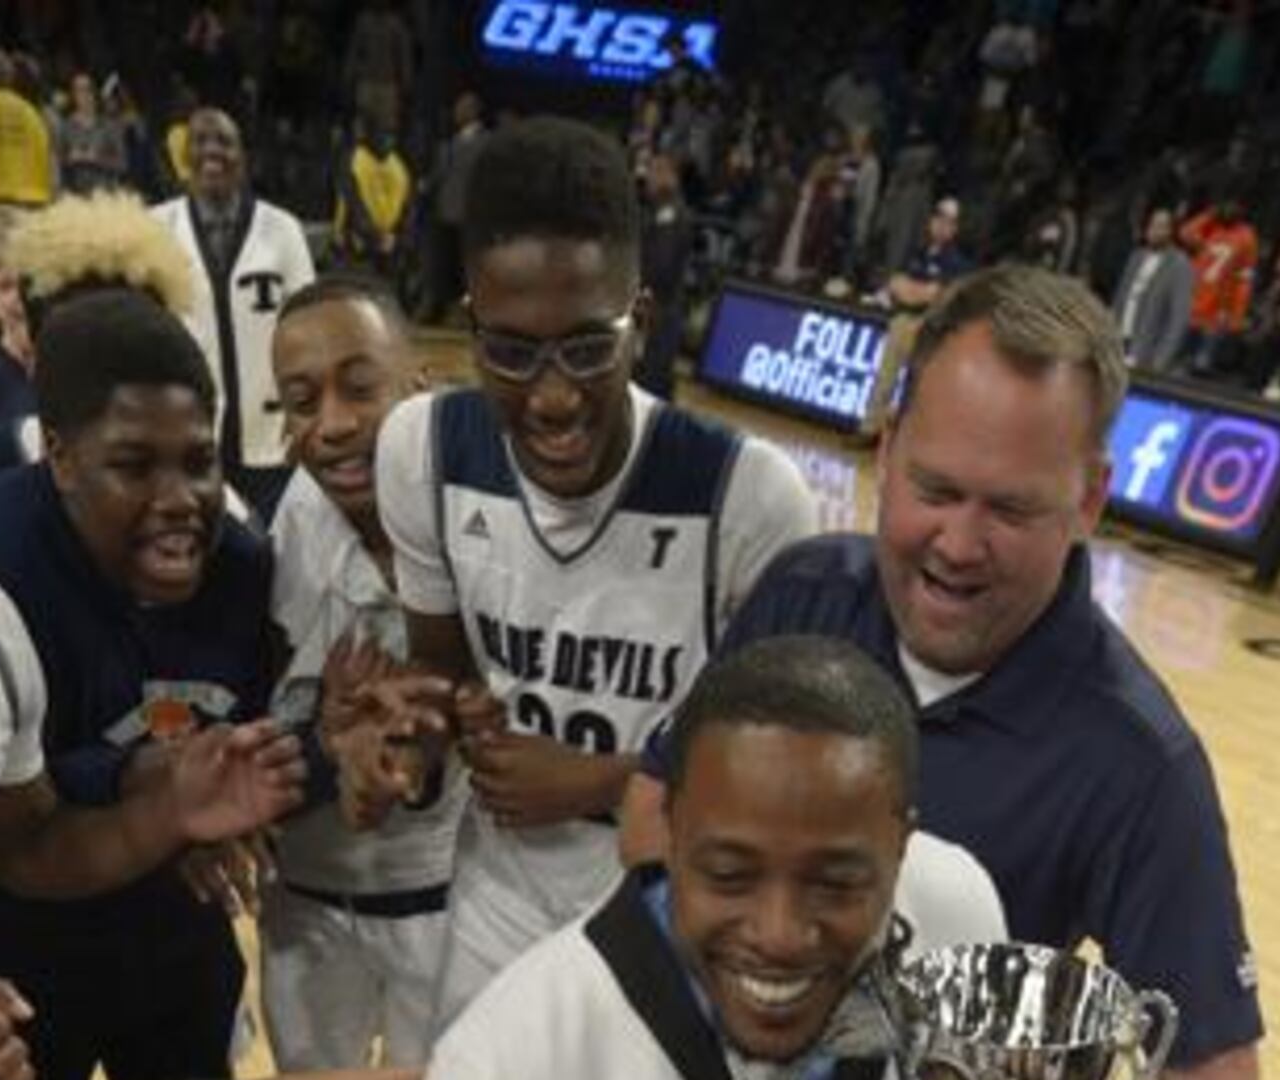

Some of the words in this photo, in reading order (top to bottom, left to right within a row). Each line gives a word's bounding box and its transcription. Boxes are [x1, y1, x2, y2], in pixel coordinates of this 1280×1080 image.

[237, 269, 284, 314] T
[793, 311, 888, 374] FOLL
[651, 526, 677, 569] T
[551, 630, 684, 704] DEVILS
